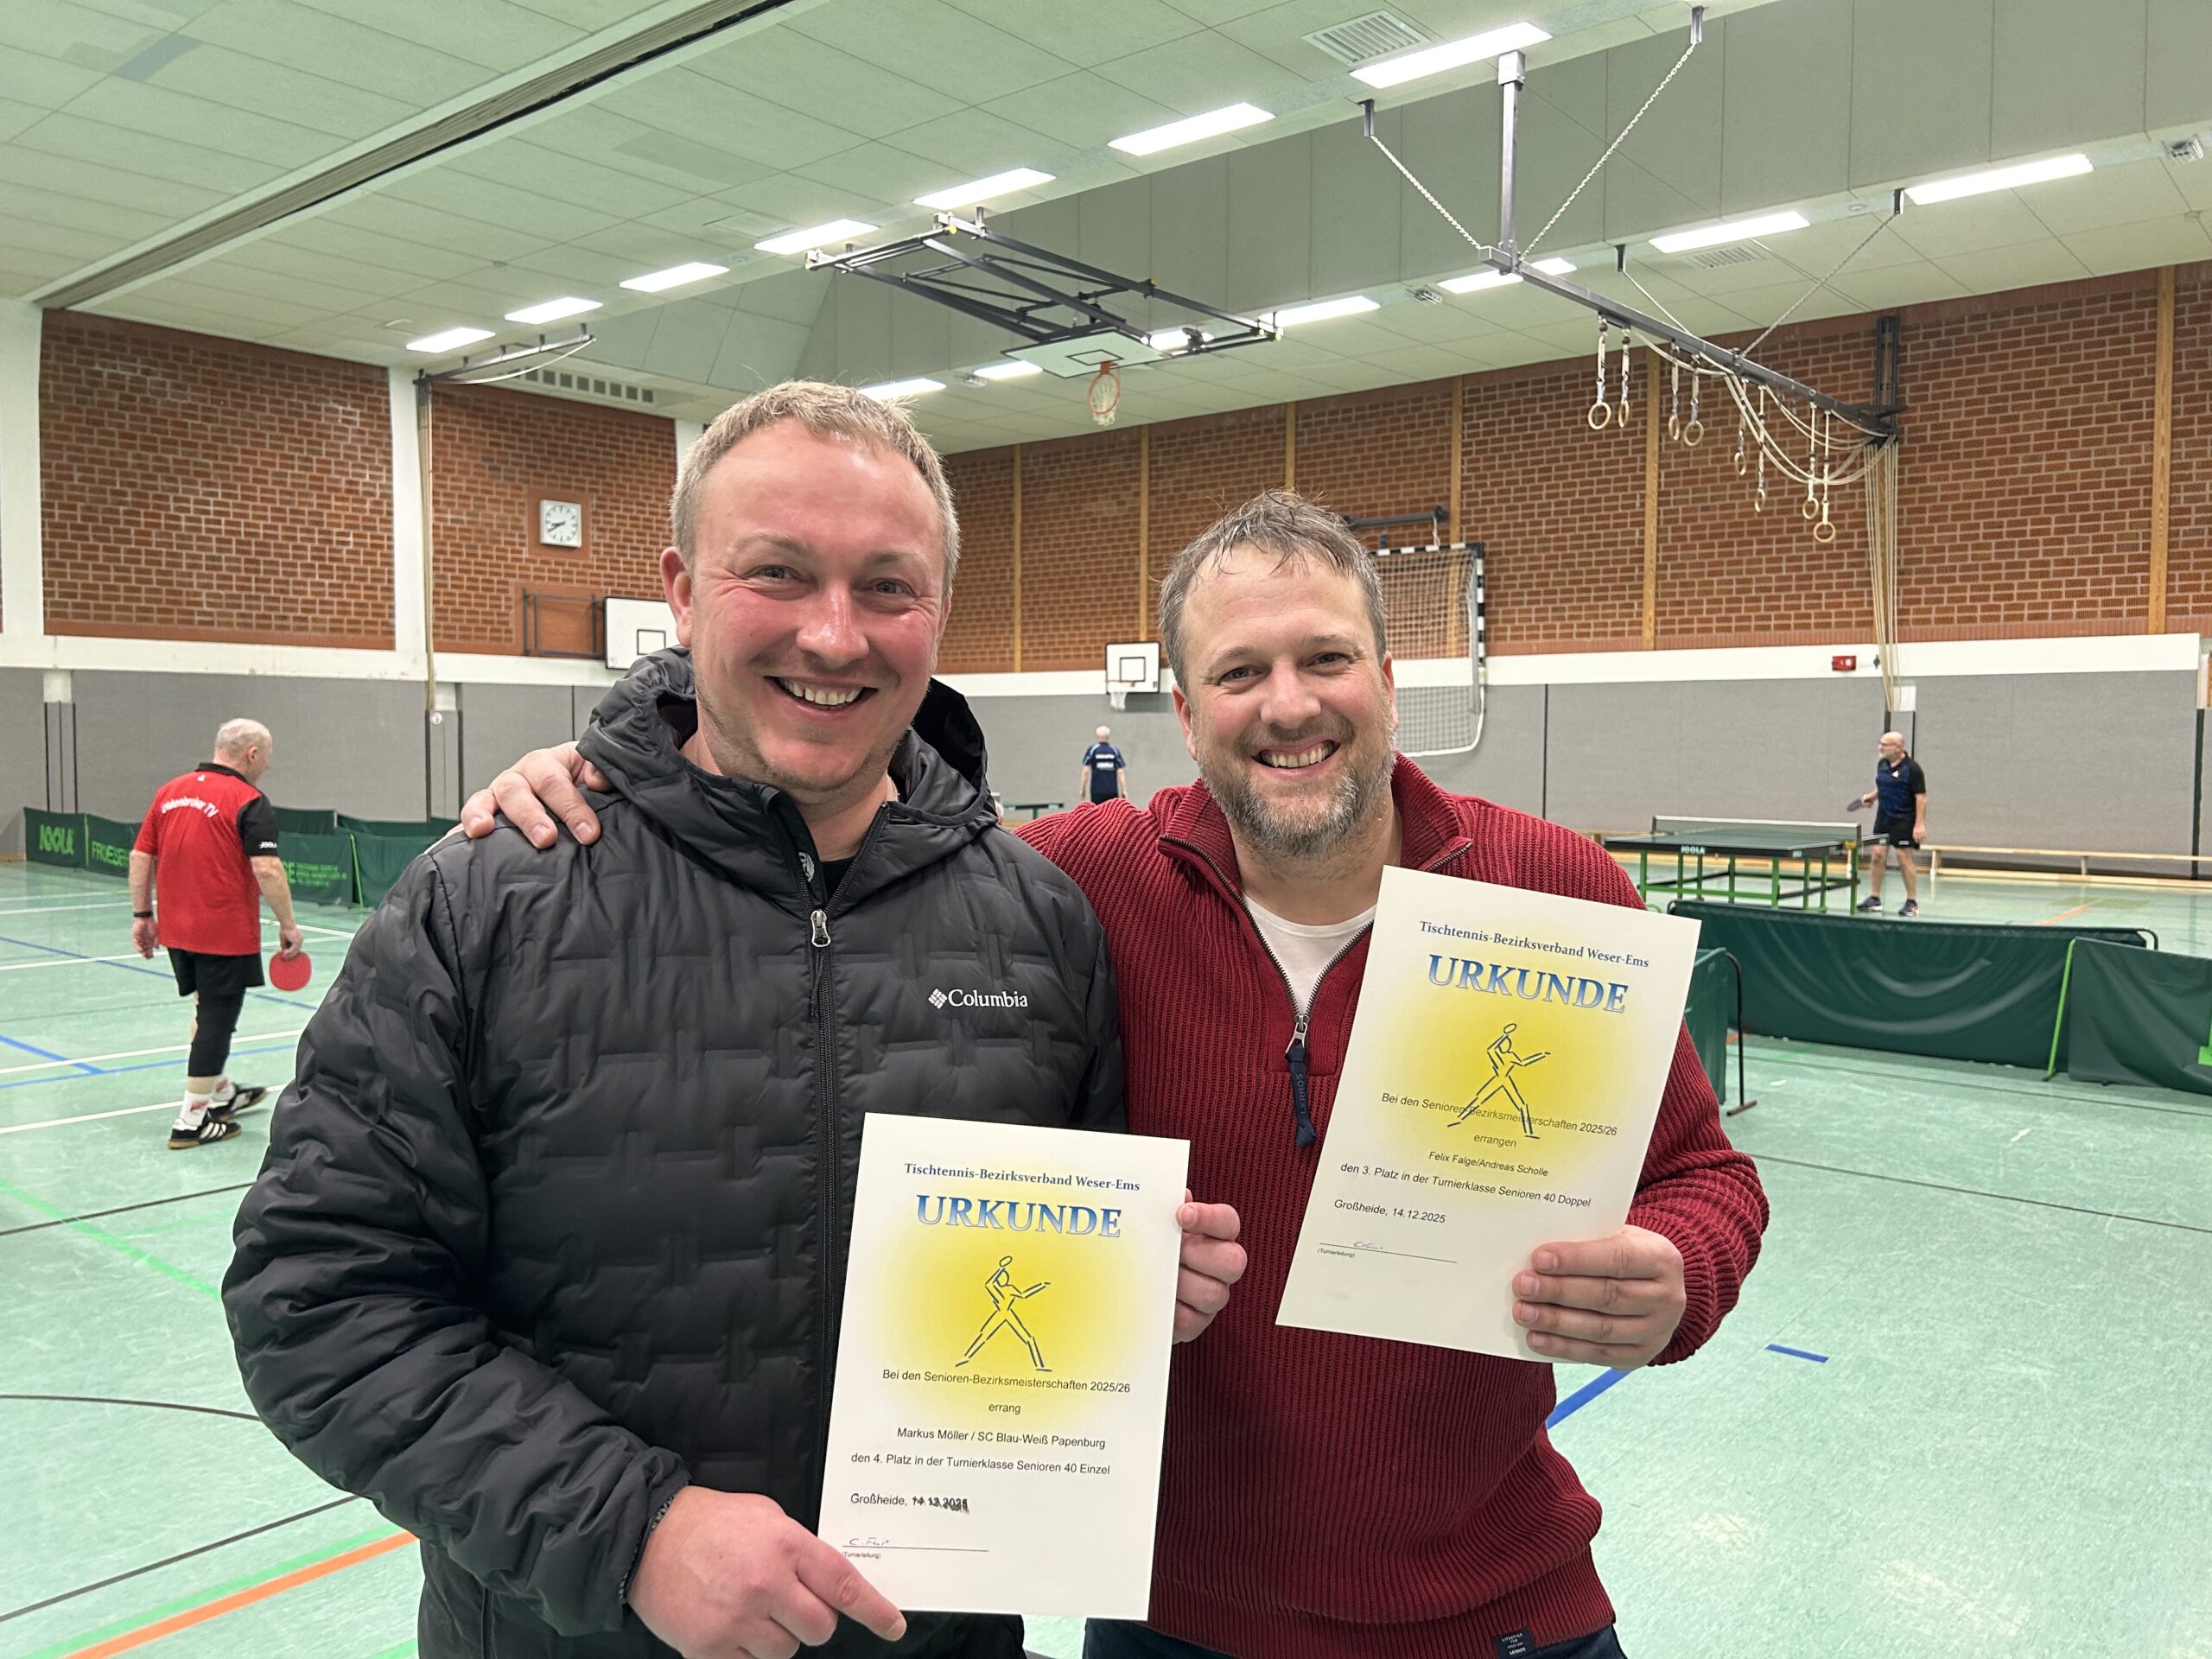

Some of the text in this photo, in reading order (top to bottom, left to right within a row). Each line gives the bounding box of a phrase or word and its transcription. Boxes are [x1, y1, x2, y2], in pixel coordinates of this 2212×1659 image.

[1681, 844, 1706, 855] JOOLA
[1420, 920, 1649, 968] Tischtennis-Bezirksverband Weser-Ems
[1428, 954, 1629, 1014] URKUNDE
[948, 988, 1028, 1007] Columbia
[1382, 1092, 1618, 1136] Bei den Senioren-Bezirksmeisterschaften 2025/26
[1473, 1134, 1517, 1148] errangen
[1428, 1151, 1548, 1177] Felix Falge/Andreas Scholle
[905, 1163, 1141, 1192] Tischtennis-Bezirksverband Weser-Ems
[1340, 1162, 1592, 1208] den 3. Platz in der Turnierklasse Senioren 40 Doppel
[916, 1194, 1122, 1238] URKUNDE
[1334, 1198, 1446, 1224] Großheide, 14.12.2025
[882, 1369, 1131, 1394] Bei den Senioren-Bezirksmeisterschaften 2025/26
[988, 1403, 1021, 1415] errang
[897, 1427, 935, 1440] Markus
[938, 1429, 969, 1441] Möller
[977, 1431, 994, 1442] SC
[996, 1432, 1049, 1446] Blau-Weiß
[1052, 1435, 1106, 1450] Papenburg
[850, 1452, 1110, 1475] den 4. Platz in der Turnierklasse Senioren 40 Einzel
[850, 1492, 907, 1507] Großheide,
